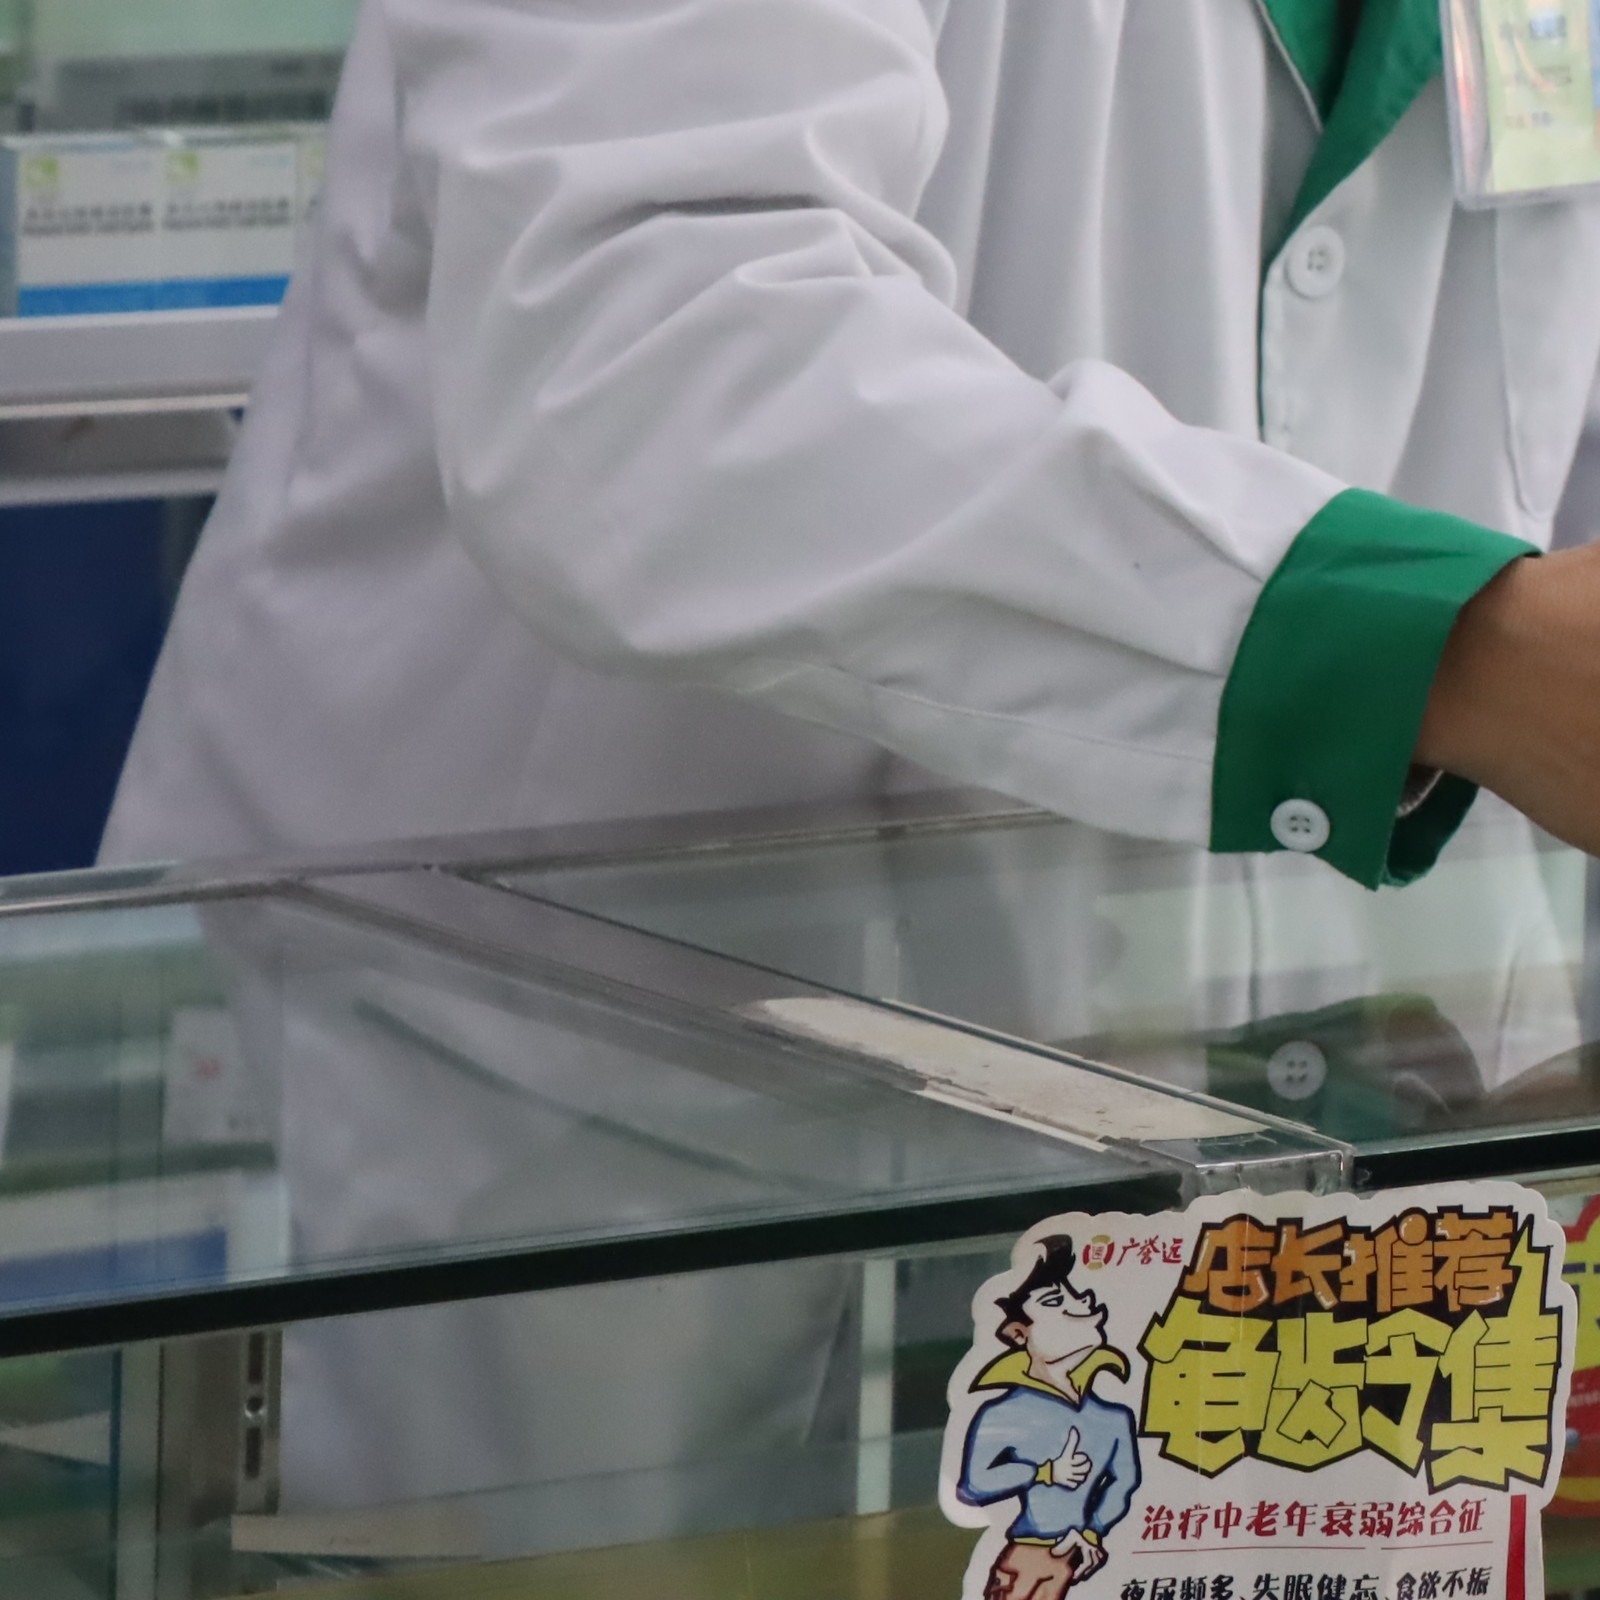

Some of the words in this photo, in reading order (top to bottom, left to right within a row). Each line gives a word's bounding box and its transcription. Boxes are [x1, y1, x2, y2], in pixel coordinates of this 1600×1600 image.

[1116, 1234, 1184, 1268] 广誉远
[1184, 1206, 1518, 1312] 店长推荐
[1140, 1497, 1488, 1542] 治疗中老年衰弱综合征
